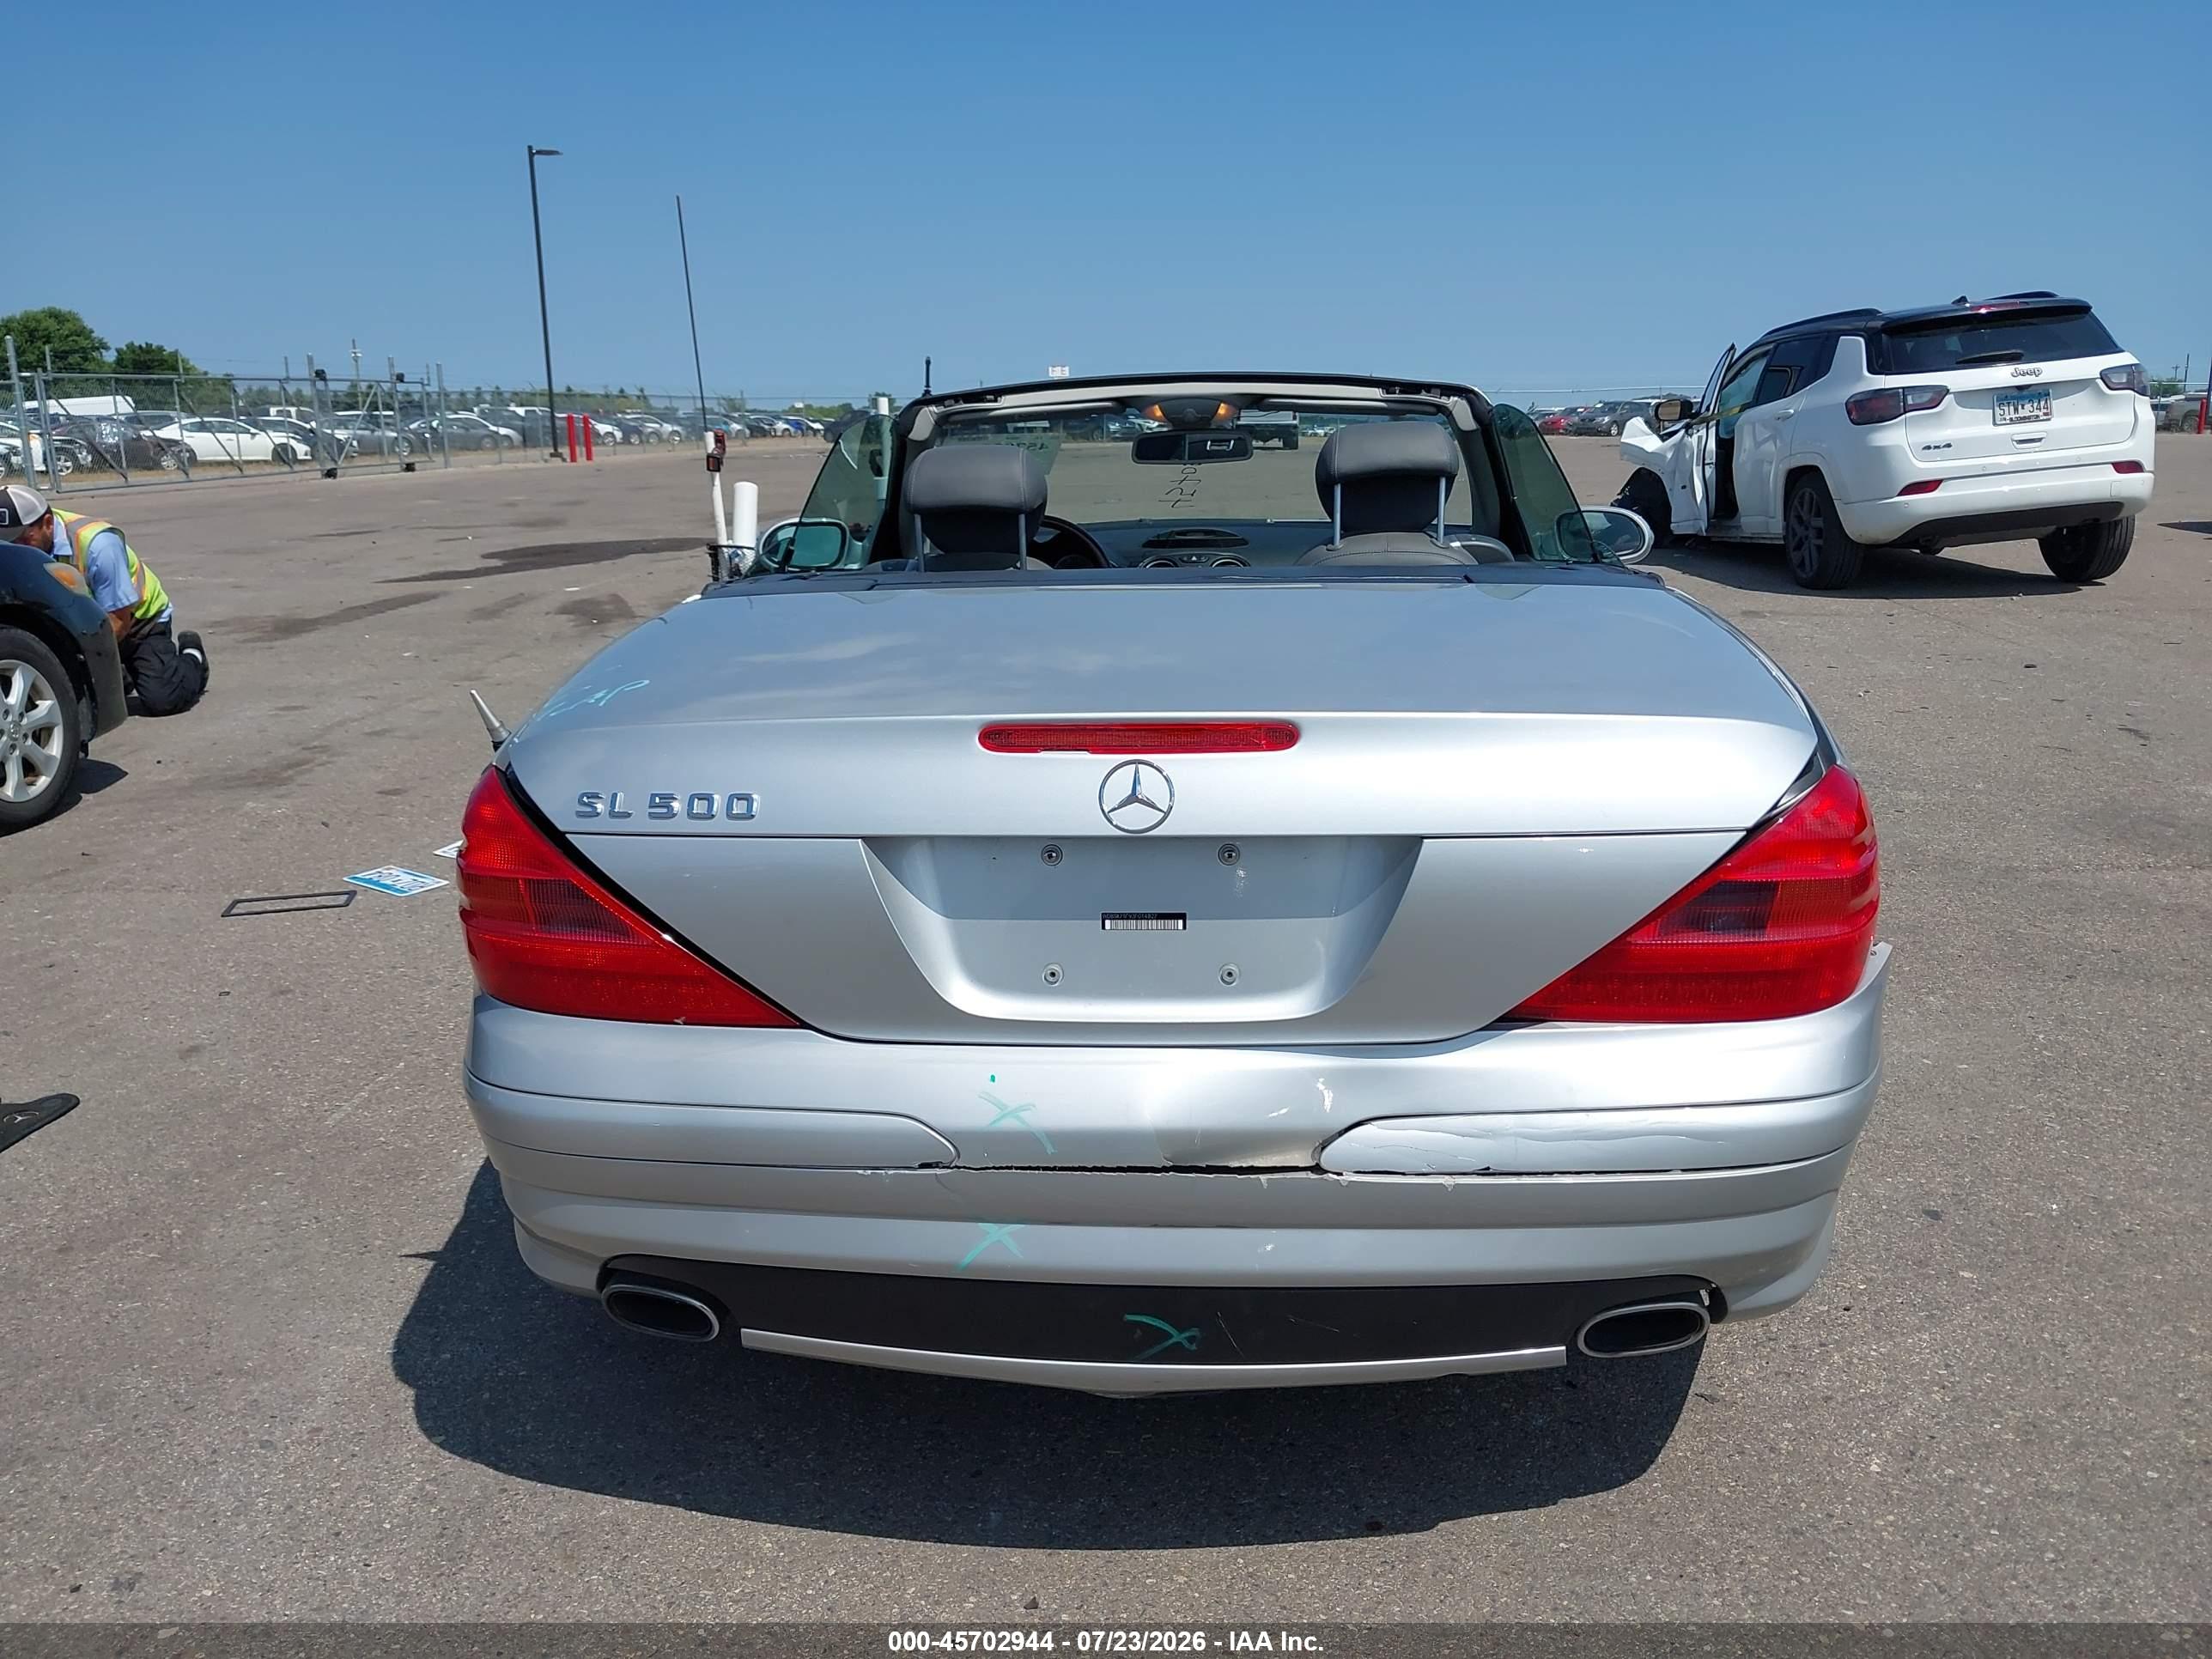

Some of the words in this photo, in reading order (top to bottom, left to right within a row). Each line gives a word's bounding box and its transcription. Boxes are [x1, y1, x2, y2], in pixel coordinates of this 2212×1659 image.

[2011, 368, 2042, 377] Jeep
[1998, 400, 2020, 416] STW
[2028, 398, 2049, 413] 344
[574, 792, 635, 819] SL
[647, 793, 760, 820] 500
